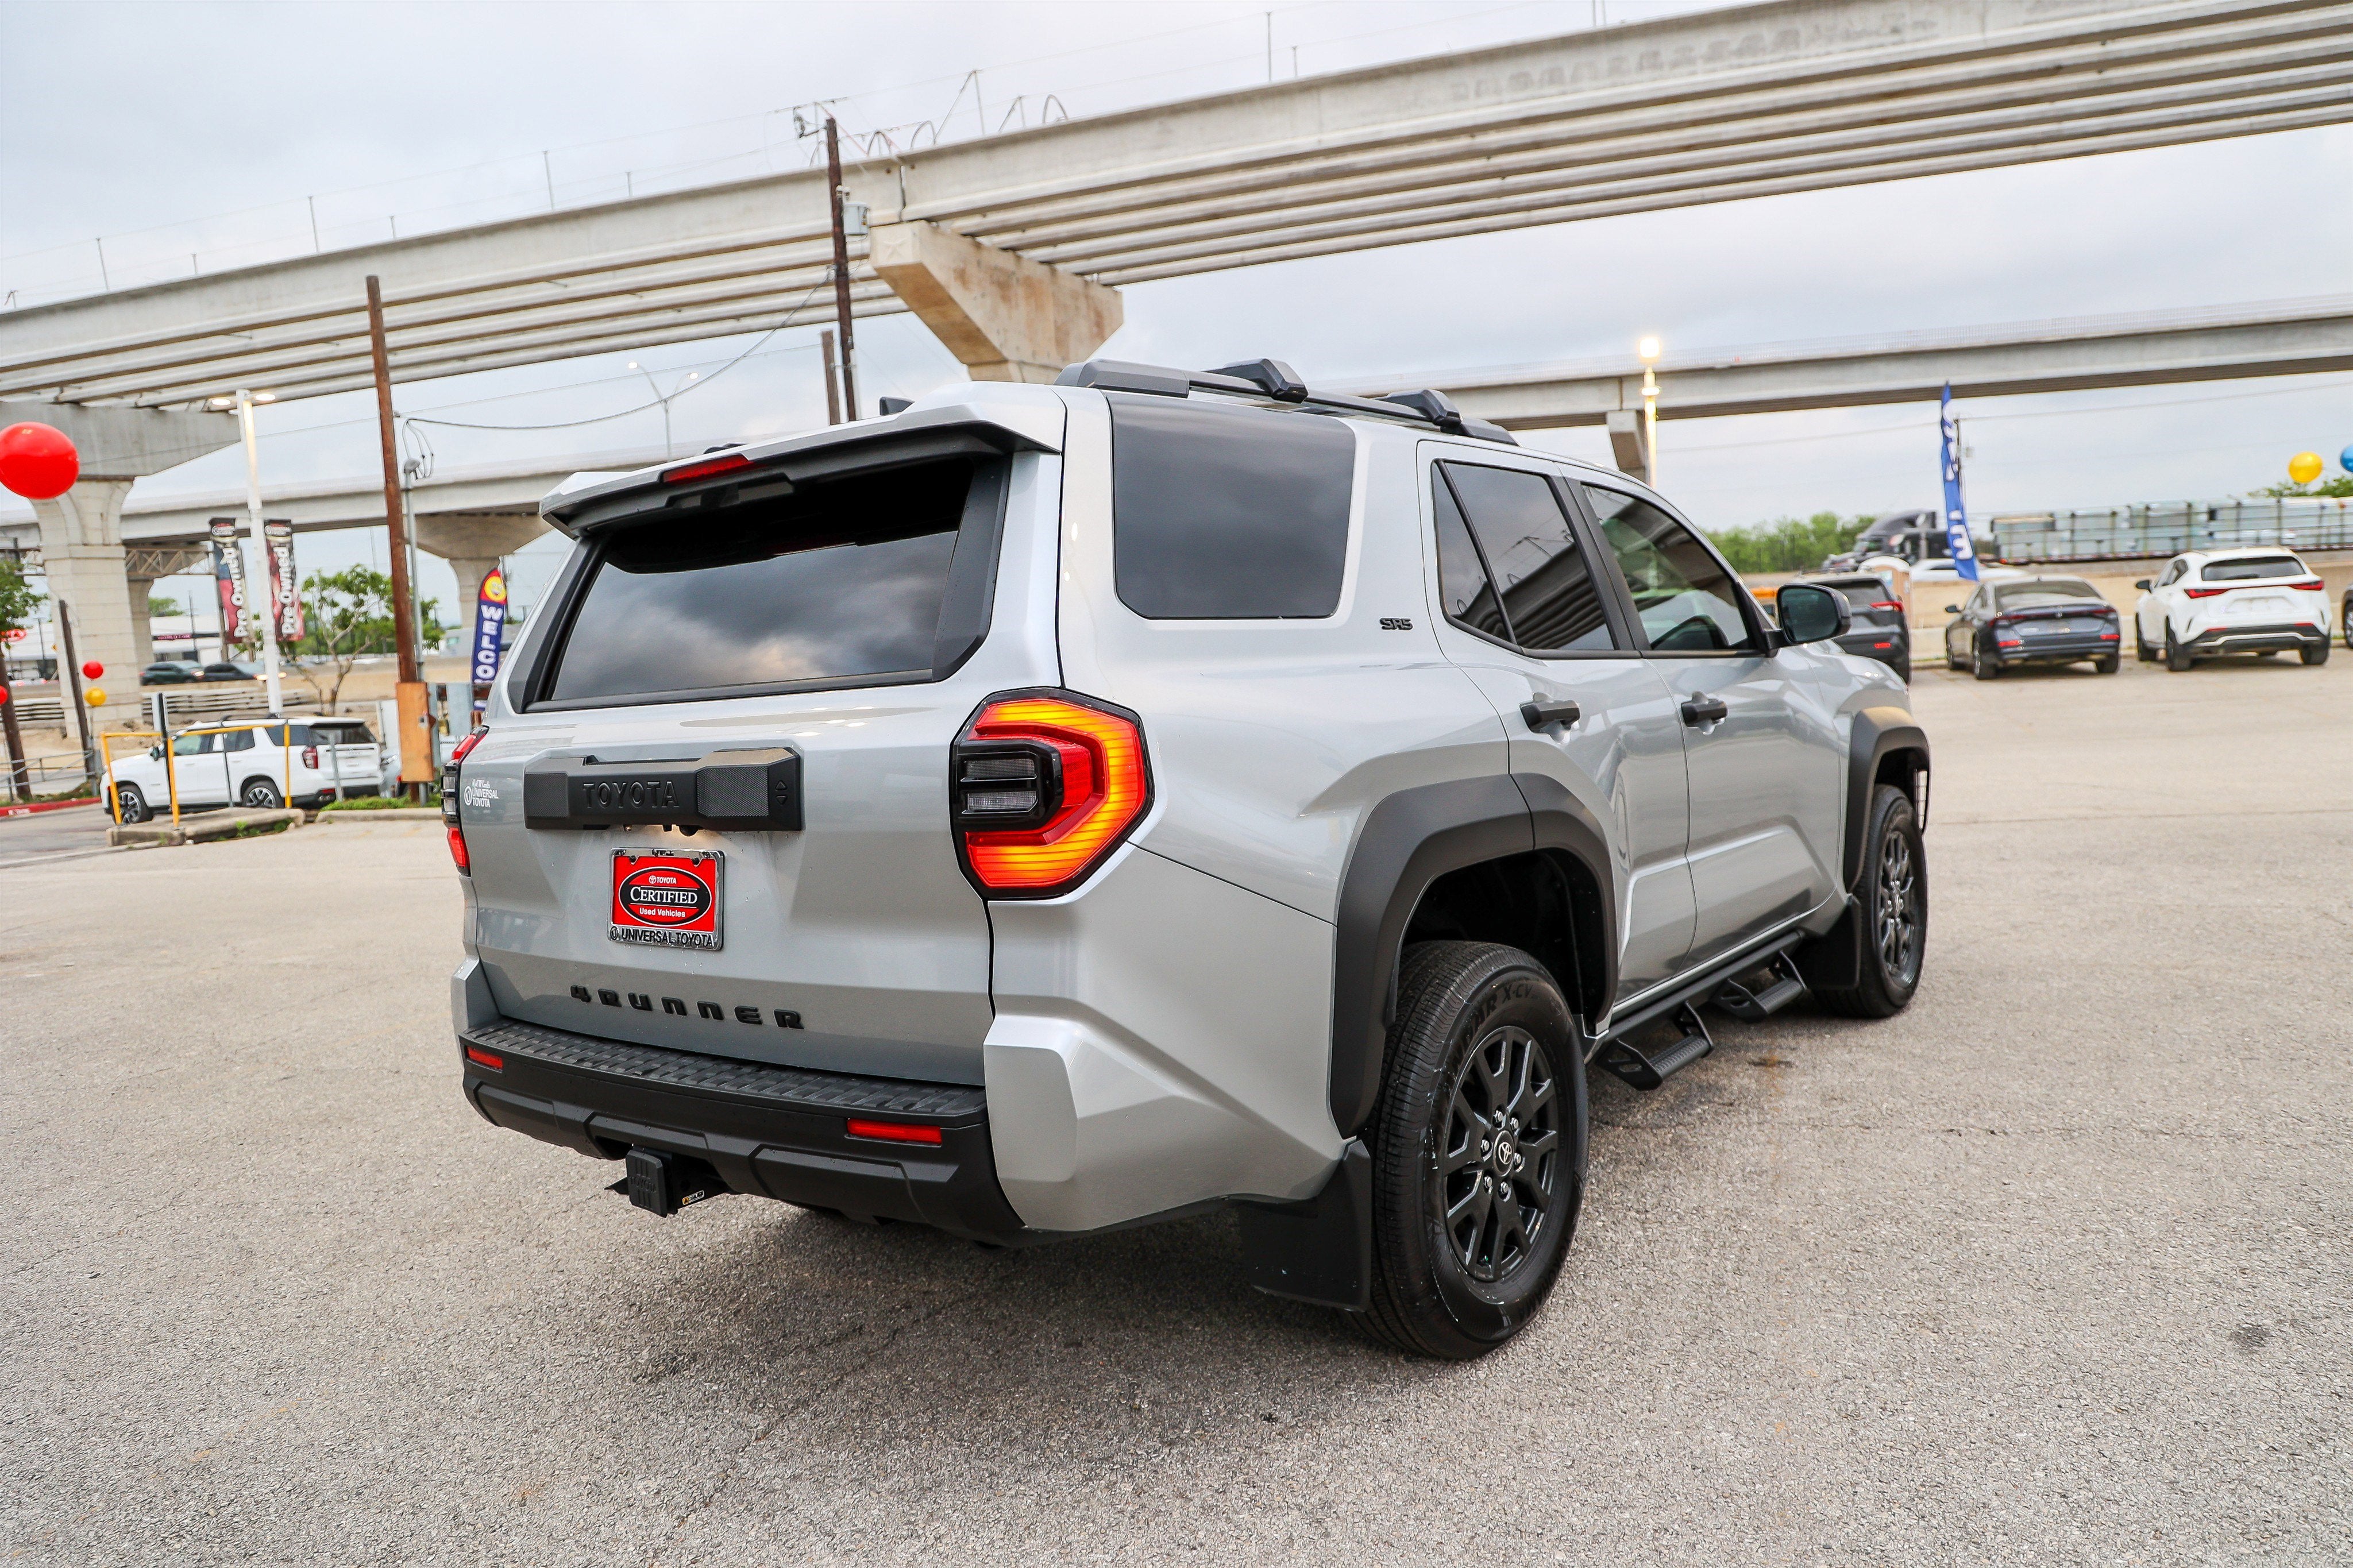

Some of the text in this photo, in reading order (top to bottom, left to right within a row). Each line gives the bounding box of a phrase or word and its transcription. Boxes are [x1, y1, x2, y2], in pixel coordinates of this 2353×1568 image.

[273, 547, 293, 604] Owned
[234, 608, 249, 637] Pre
[281, 606, 295, 634] Pre
[474, 605, 503, 709] WELCO
[472, 787, 499, 799] UNIVERSAL
[472, 797, 491, 808] TOYOTA
[583, 781, 680, 809] TOYOTA
[639, 907, 685, 917] Used Vehicles
[622, 928, 714, 948] UNIVERSAL TOYOTA
[570, 984, 805, 1030] 4RUNNER
